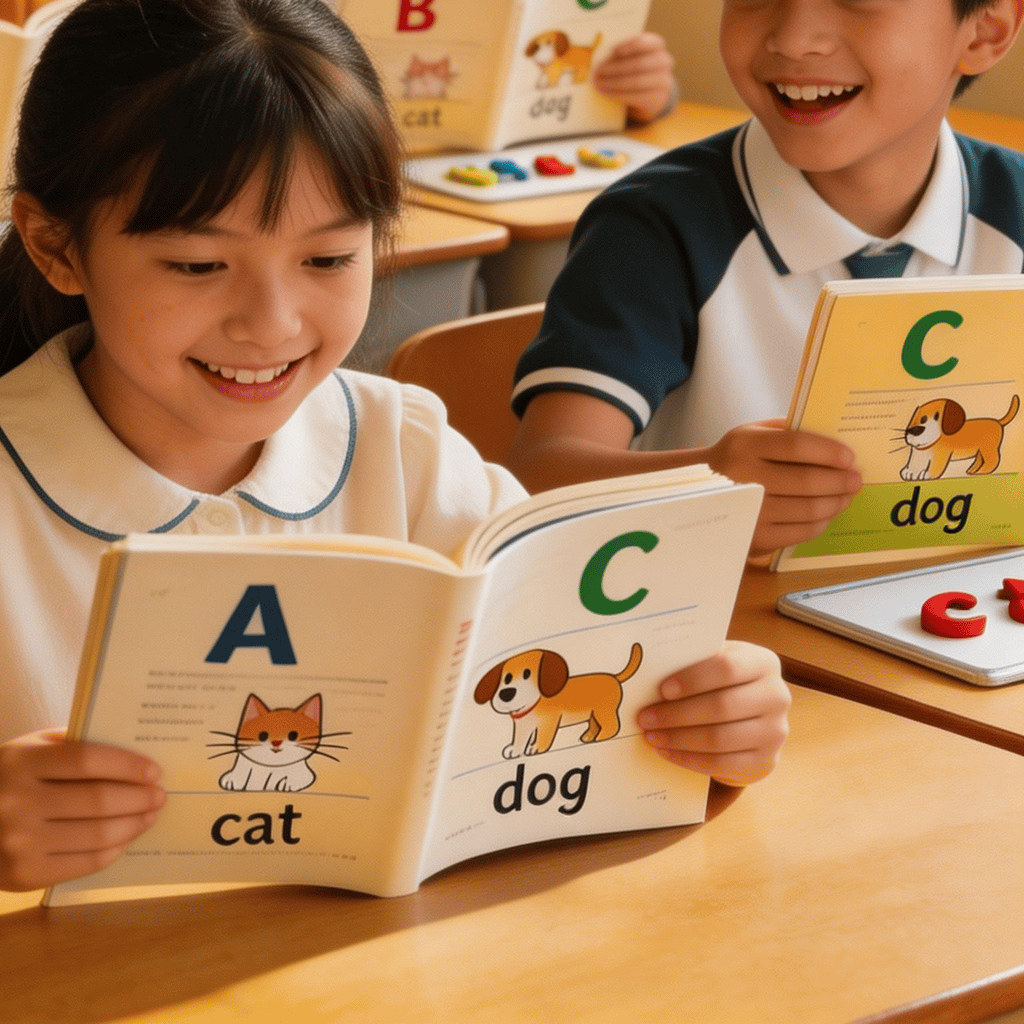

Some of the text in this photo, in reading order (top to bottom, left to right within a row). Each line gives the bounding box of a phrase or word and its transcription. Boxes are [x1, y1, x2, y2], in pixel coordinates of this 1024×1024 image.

[403, 108, 441, 127] cat
[529, 94, 573, 122] dog
[901, 309, 964, 380] C
[890, 485, 974, 535] dog
[579, 530, 660, 616] C
[204, 584, 298, 666] A
[492, 762, 592, 815] dog
[210, 804, 303, 847] cat
